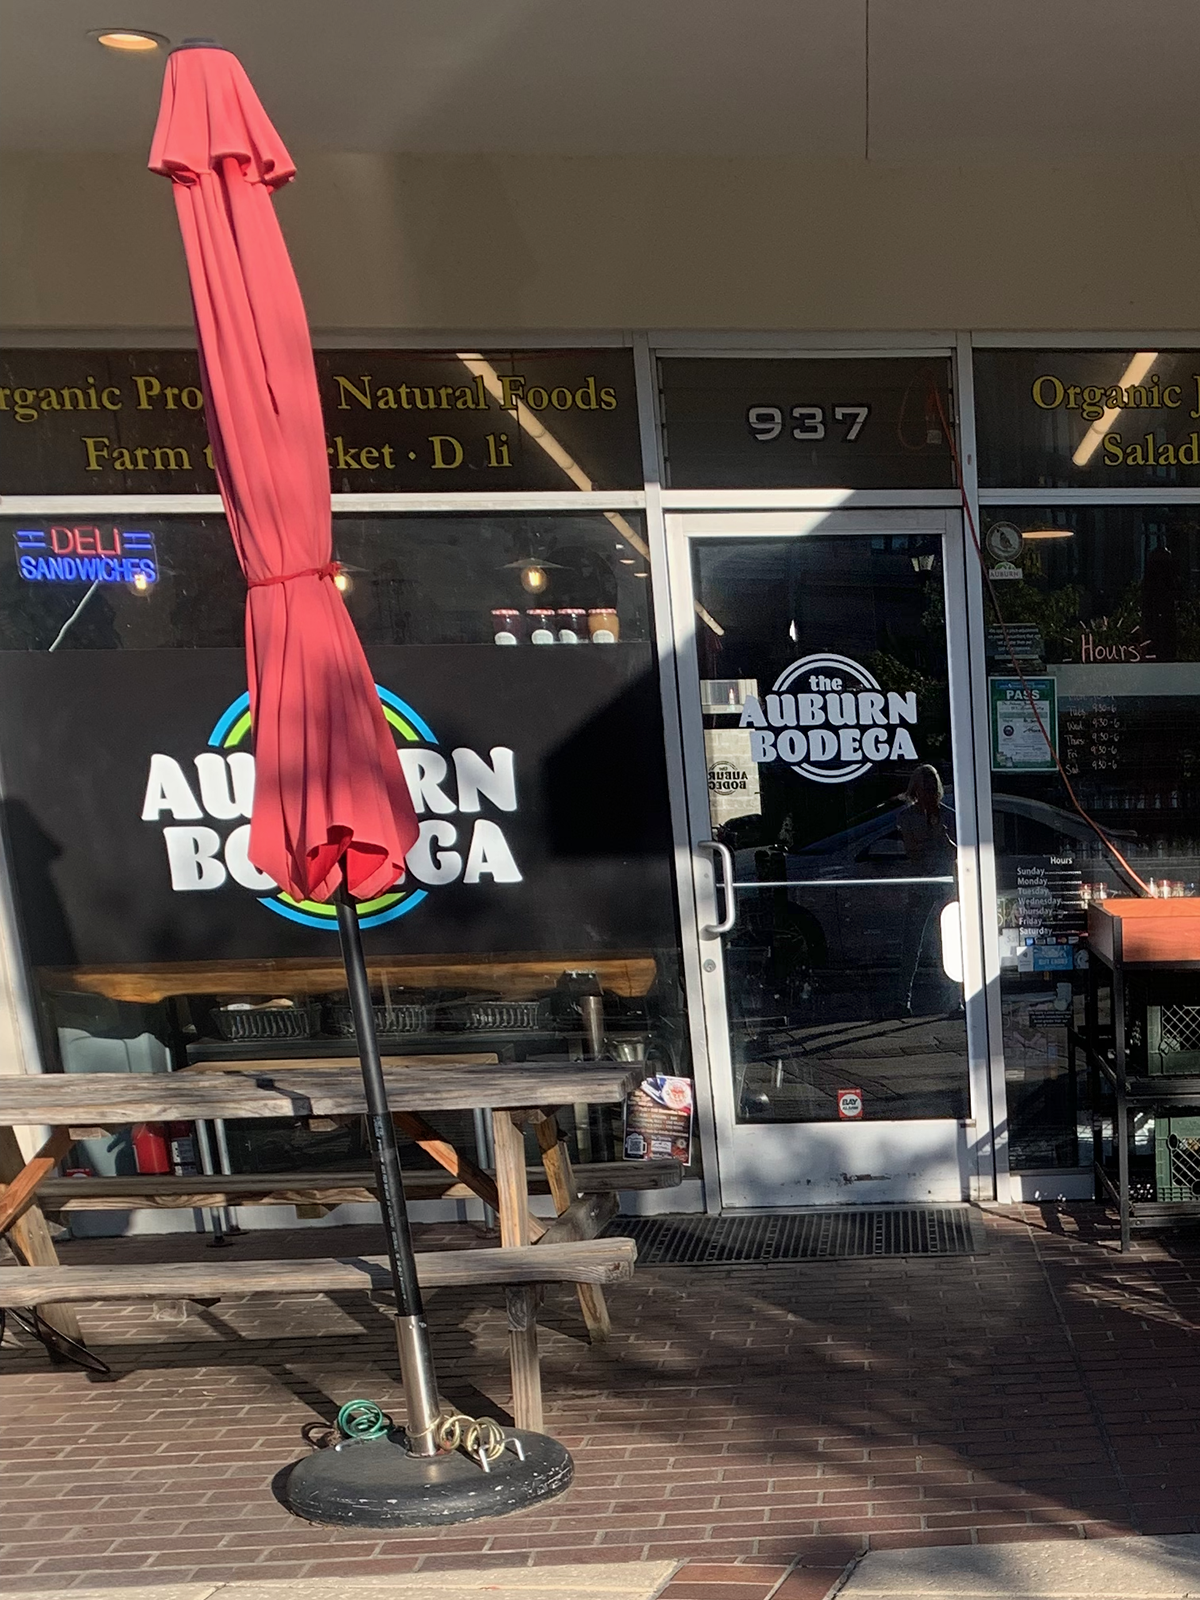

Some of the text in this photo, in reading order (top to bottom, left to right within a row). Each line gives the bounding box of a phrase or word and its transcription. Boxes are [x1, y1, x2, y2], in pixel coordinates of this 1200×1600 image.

[0, 376, 122, 422] rganic
[333, 376, 490, 411] Natural
[498, 376, 619, 411] Foods
[1031, 375, 1182, 421] Organic
[748, 406, 869, 441] 937
[82, 436, 193, 471] Farm
[1102, 432, 1200, 467] Salad
[50, 526, 122, 555] DELI
[19, 556, 156, 583] SANDWICHES
[989, 570, 1019, 578] AUBURN
[1080, 632, 1141, 663] Hours
[809, 675, 843, 691] the
[1006, 689, 1040, 700] PASS
[738, 691, 918, 727] AUBURN
[750, 727, 918, 762] BODEGA
[141, 746, 517, 821] AURN
[163, 819, 523, 892] BOGA
[1050, 856, 1073, 865] Hours
[1017, 867, 1045, 877] Sunday
[1018, 877, 1048, 887] Monday
[1018, 888, 1050, 897] Tuesday
[1018, 898, 1062, 907] Wednesday
[1019, 917, 1042, 926] Friday
[1020, 927, 1053, 937] Saturday
